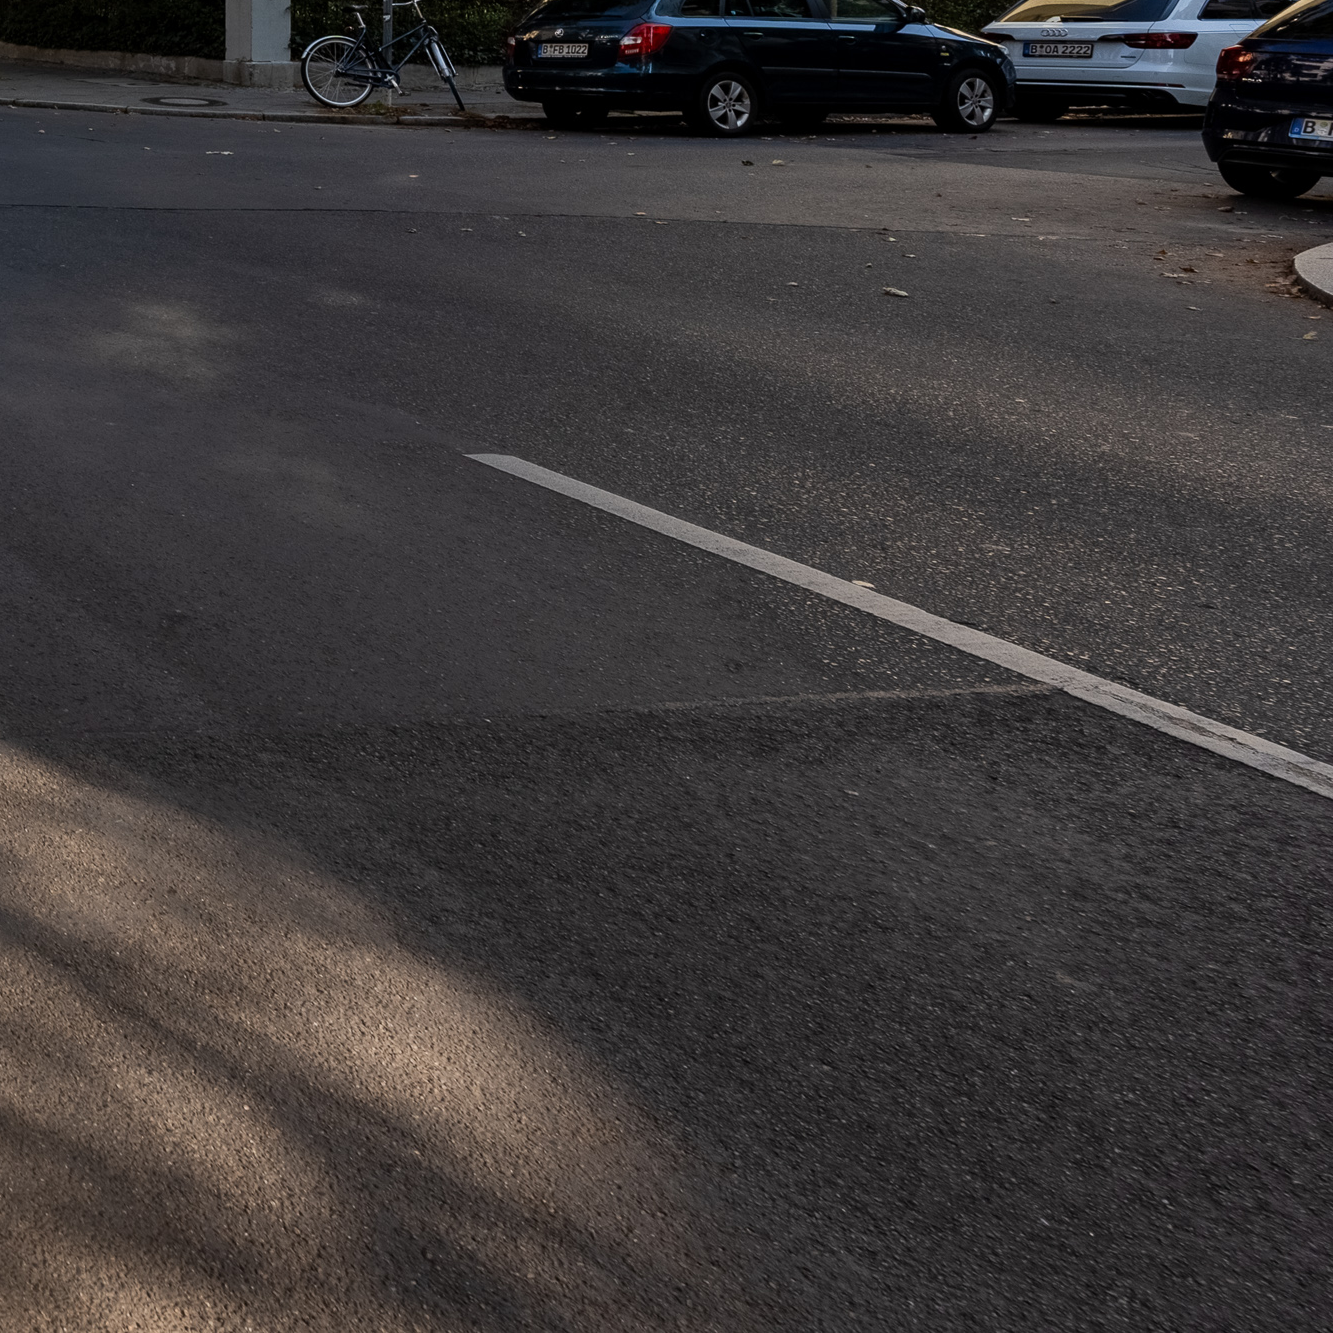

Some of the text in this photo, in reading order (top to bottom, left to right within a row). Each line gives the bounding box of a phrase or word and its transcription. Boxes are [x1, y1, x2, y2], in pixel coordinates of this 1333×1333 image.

[565, 45, 588, 54] 1022
[1061, 46, 1090, 55] 2222
[1302, 120, 1316, 134] B
